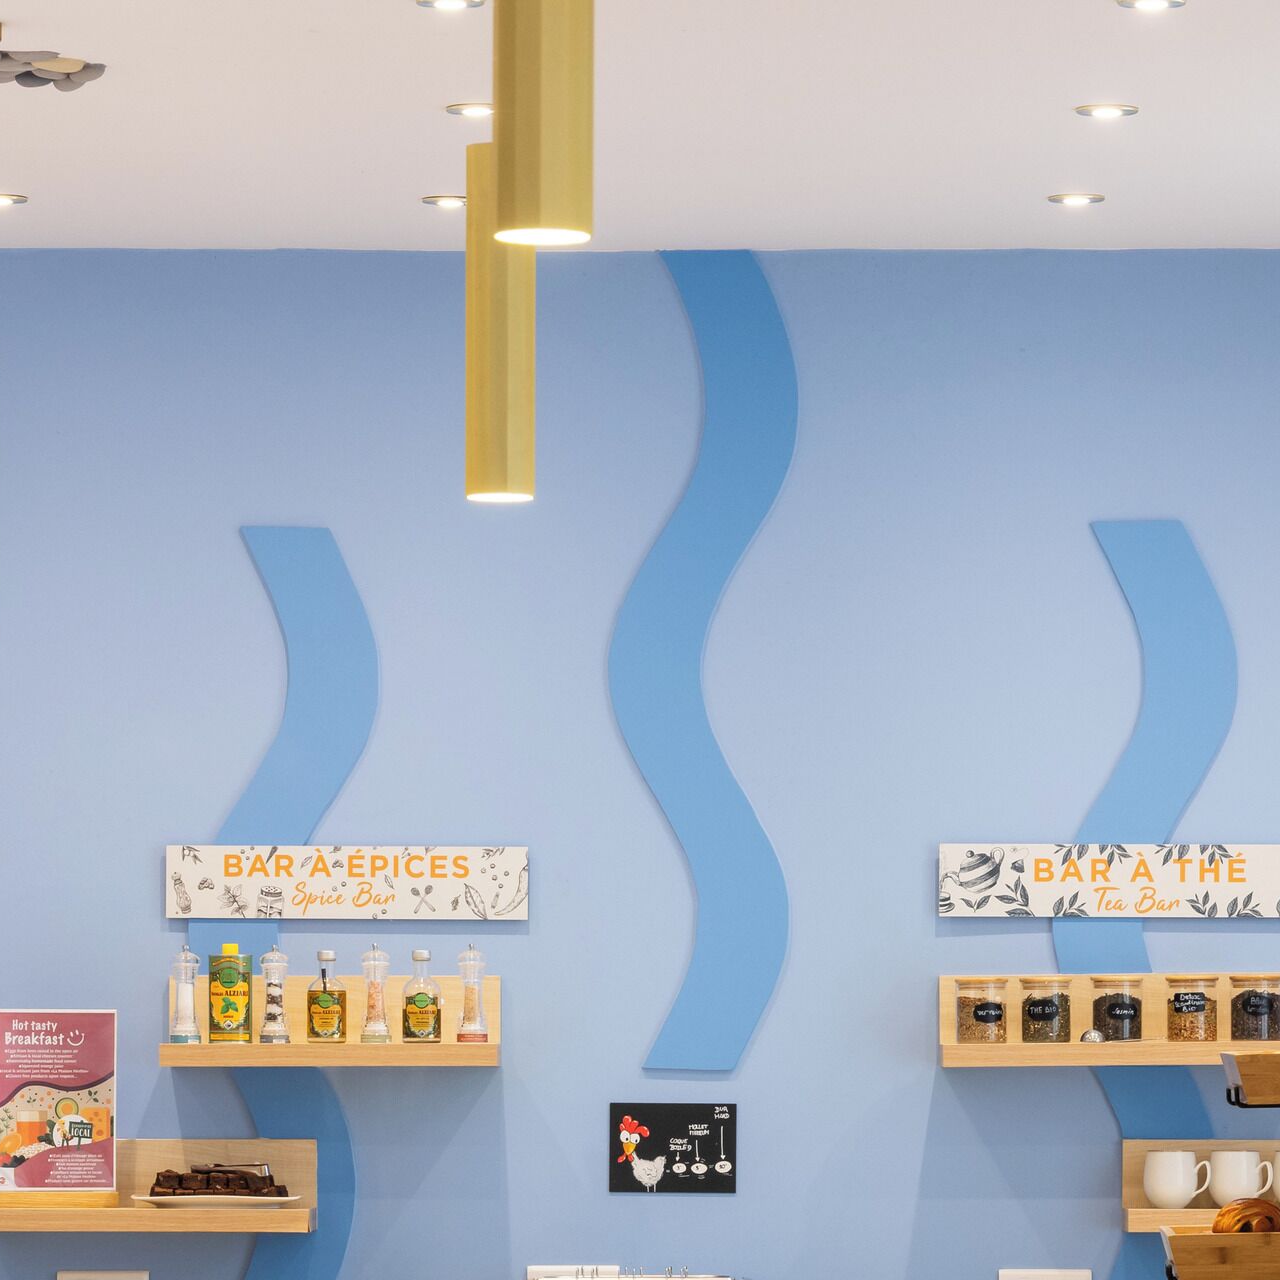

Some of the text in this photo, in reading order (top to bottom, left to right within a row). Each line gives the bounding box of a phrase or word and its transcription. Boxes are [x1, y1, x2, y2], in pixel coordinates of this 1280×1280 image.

[223, 848, 470, 879] BAR À ÉPICES
[1034, 851, 1247, 883] BAR À THÉ
[291, 881, 396, 916] Spice Bar
[1093, 886, 1180, 914] Tea Bar
[4, 1031, 65, 1046] Breakfast
[12, 1019, 58, 1032] Hot tasty
[71, 1127, 91, 1137] LOCAL
